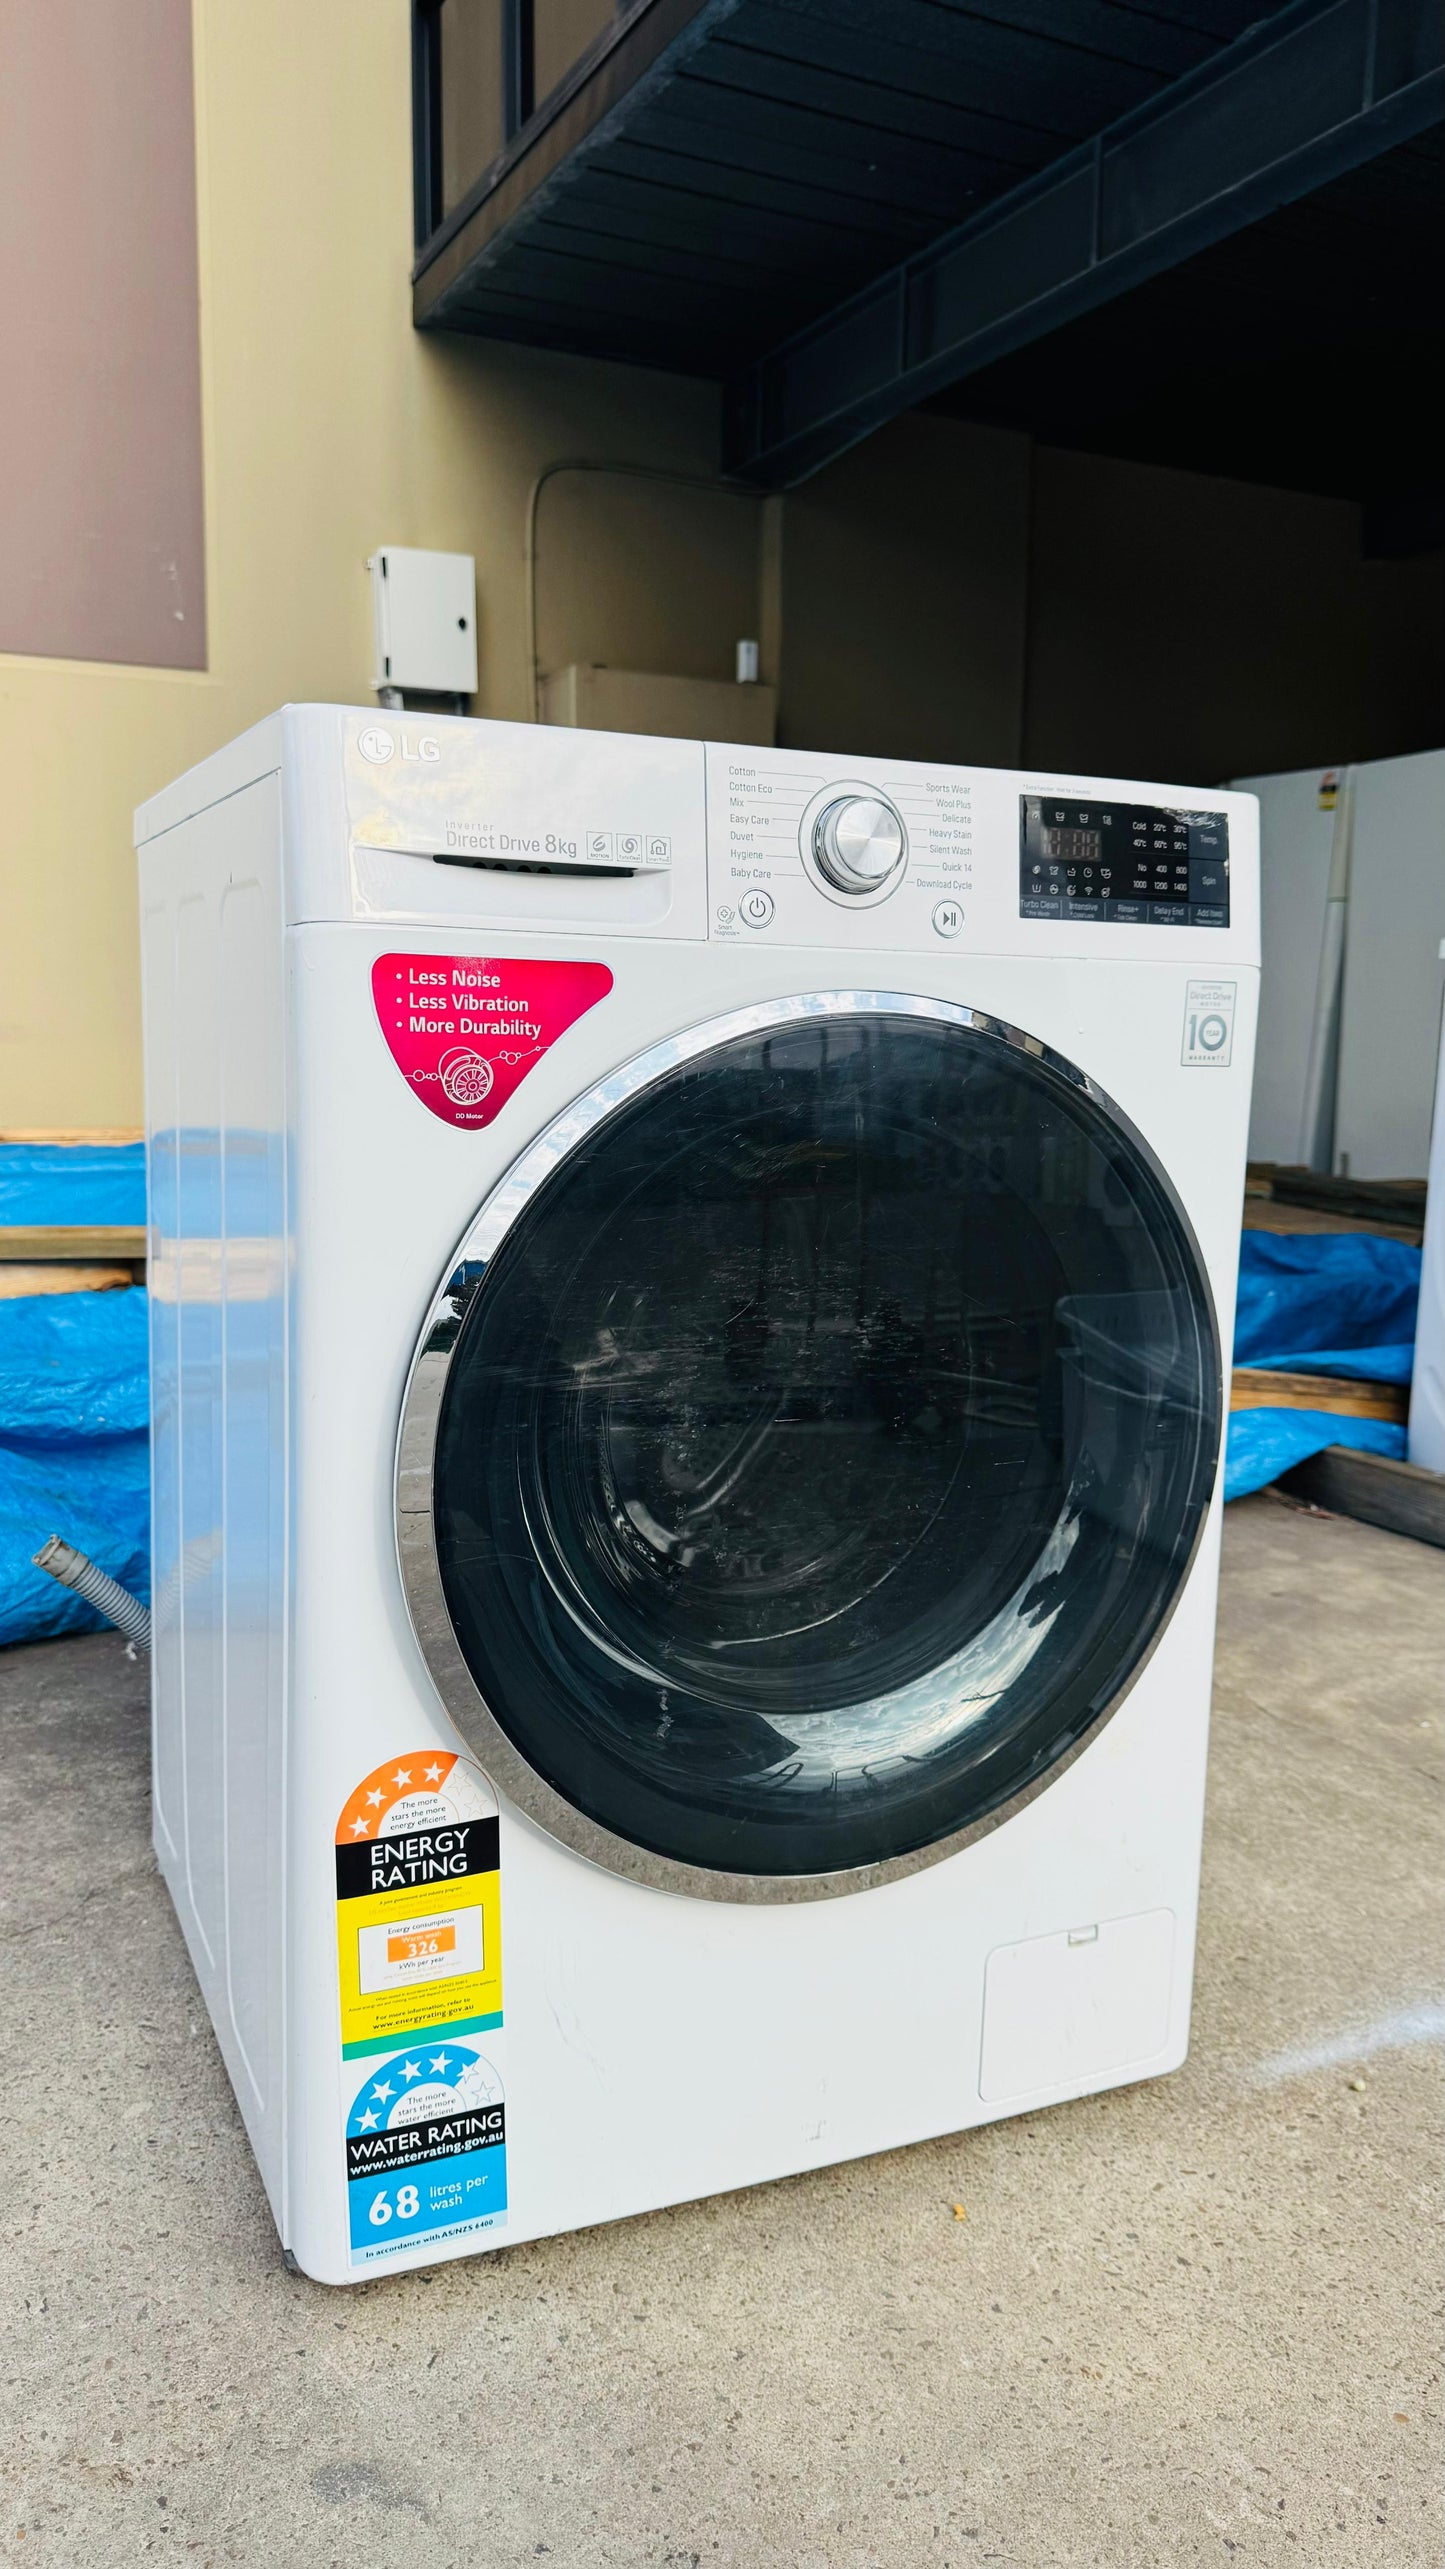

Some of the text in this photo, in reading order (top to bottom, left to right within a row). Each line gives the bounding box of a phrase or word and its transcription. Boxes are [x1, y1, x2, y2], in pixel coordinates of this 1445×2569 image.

[400, 734, 442, 763] LG
[728, 766, 756, 777] Cotton
[729, 782, 773, 794] Cotton Eco
[925, 782, 971, 795] Sports Wear
[729, 797, 745, 808] Mix
[935, 798, 972, 810] Wool Plus
[729, 814, 770, 827] Easy Care
[942, 813, 972, 824] Delicate
[445, 820, 496, 832] Inverter
[1132, 821, 1147, 831] Cold
[730, 830, 754, 842] Duvet
[929, 828, 972, 840] Heavy Stain
[446, 830, 578, 859] Direct Drive 8kg
[929, 844, 973, 856] Silent Wash
[730, 849, 764, 861] Hygiene
[730, 867, 772, 880] Baby Care
[942, 861, 973, 873] Quick 14
[1137, 863, 1187, 875] No 400 800
[916, 878, 973, 892] Download Cycle
[1133, 880, 1187, 892] 1000 1200 1400
[1202, 876, 1217, 887] Spin
[1020, 899, 1059, 910] Turbo Clean
[1068, 901, 1099, 912] Intensive
[1153, 906, 1184, 916] Delay End
[408, 967, 501, 988] Less Noise
[408, 991, 529, 1013] Less Vibration
[1190, 991, 1232, 1001] Direct Drive
[409, 1016, 542, 1041] More Durability
[1188, 1014, 1228, 1052] 10
[466, 1112, 484, 1120] Motor
[400, 1798, 438, 1810] The more
[391, 1806, 447, 1822] stars the more
[390, 1815, 447, 1831] energy efficient
[370, 1828, 470, 1866] ENERGY
[371, 1853, 468, 1890] RATING
[387, 1917, 455, 1935] Energy consumption
[402, 1931, 442, 1943] Warm wash
[408, 1938, 439, 1958] 326
[399, 1955, 445, 1970] kWh per year
[372, 2004, 474, 2030] www.energyrating.gov.au
[406, 2091, 447, 2105] The more
[398, 2098, 456, 2117] stars the more
[397, 2107, 454, 2125] water efficient
[350, 2111, 503, 2161] WATER RATING
[350, 2131, 504, 2176] www.waterrating.gov.au
[430, 2174, 488, 2198] litres per
[368, 2184, 420, 2226] 68
[430, 2194, 463, 2212] wash
[365, 2219, 494, 2259] In accordance with AS/NZS 6400
